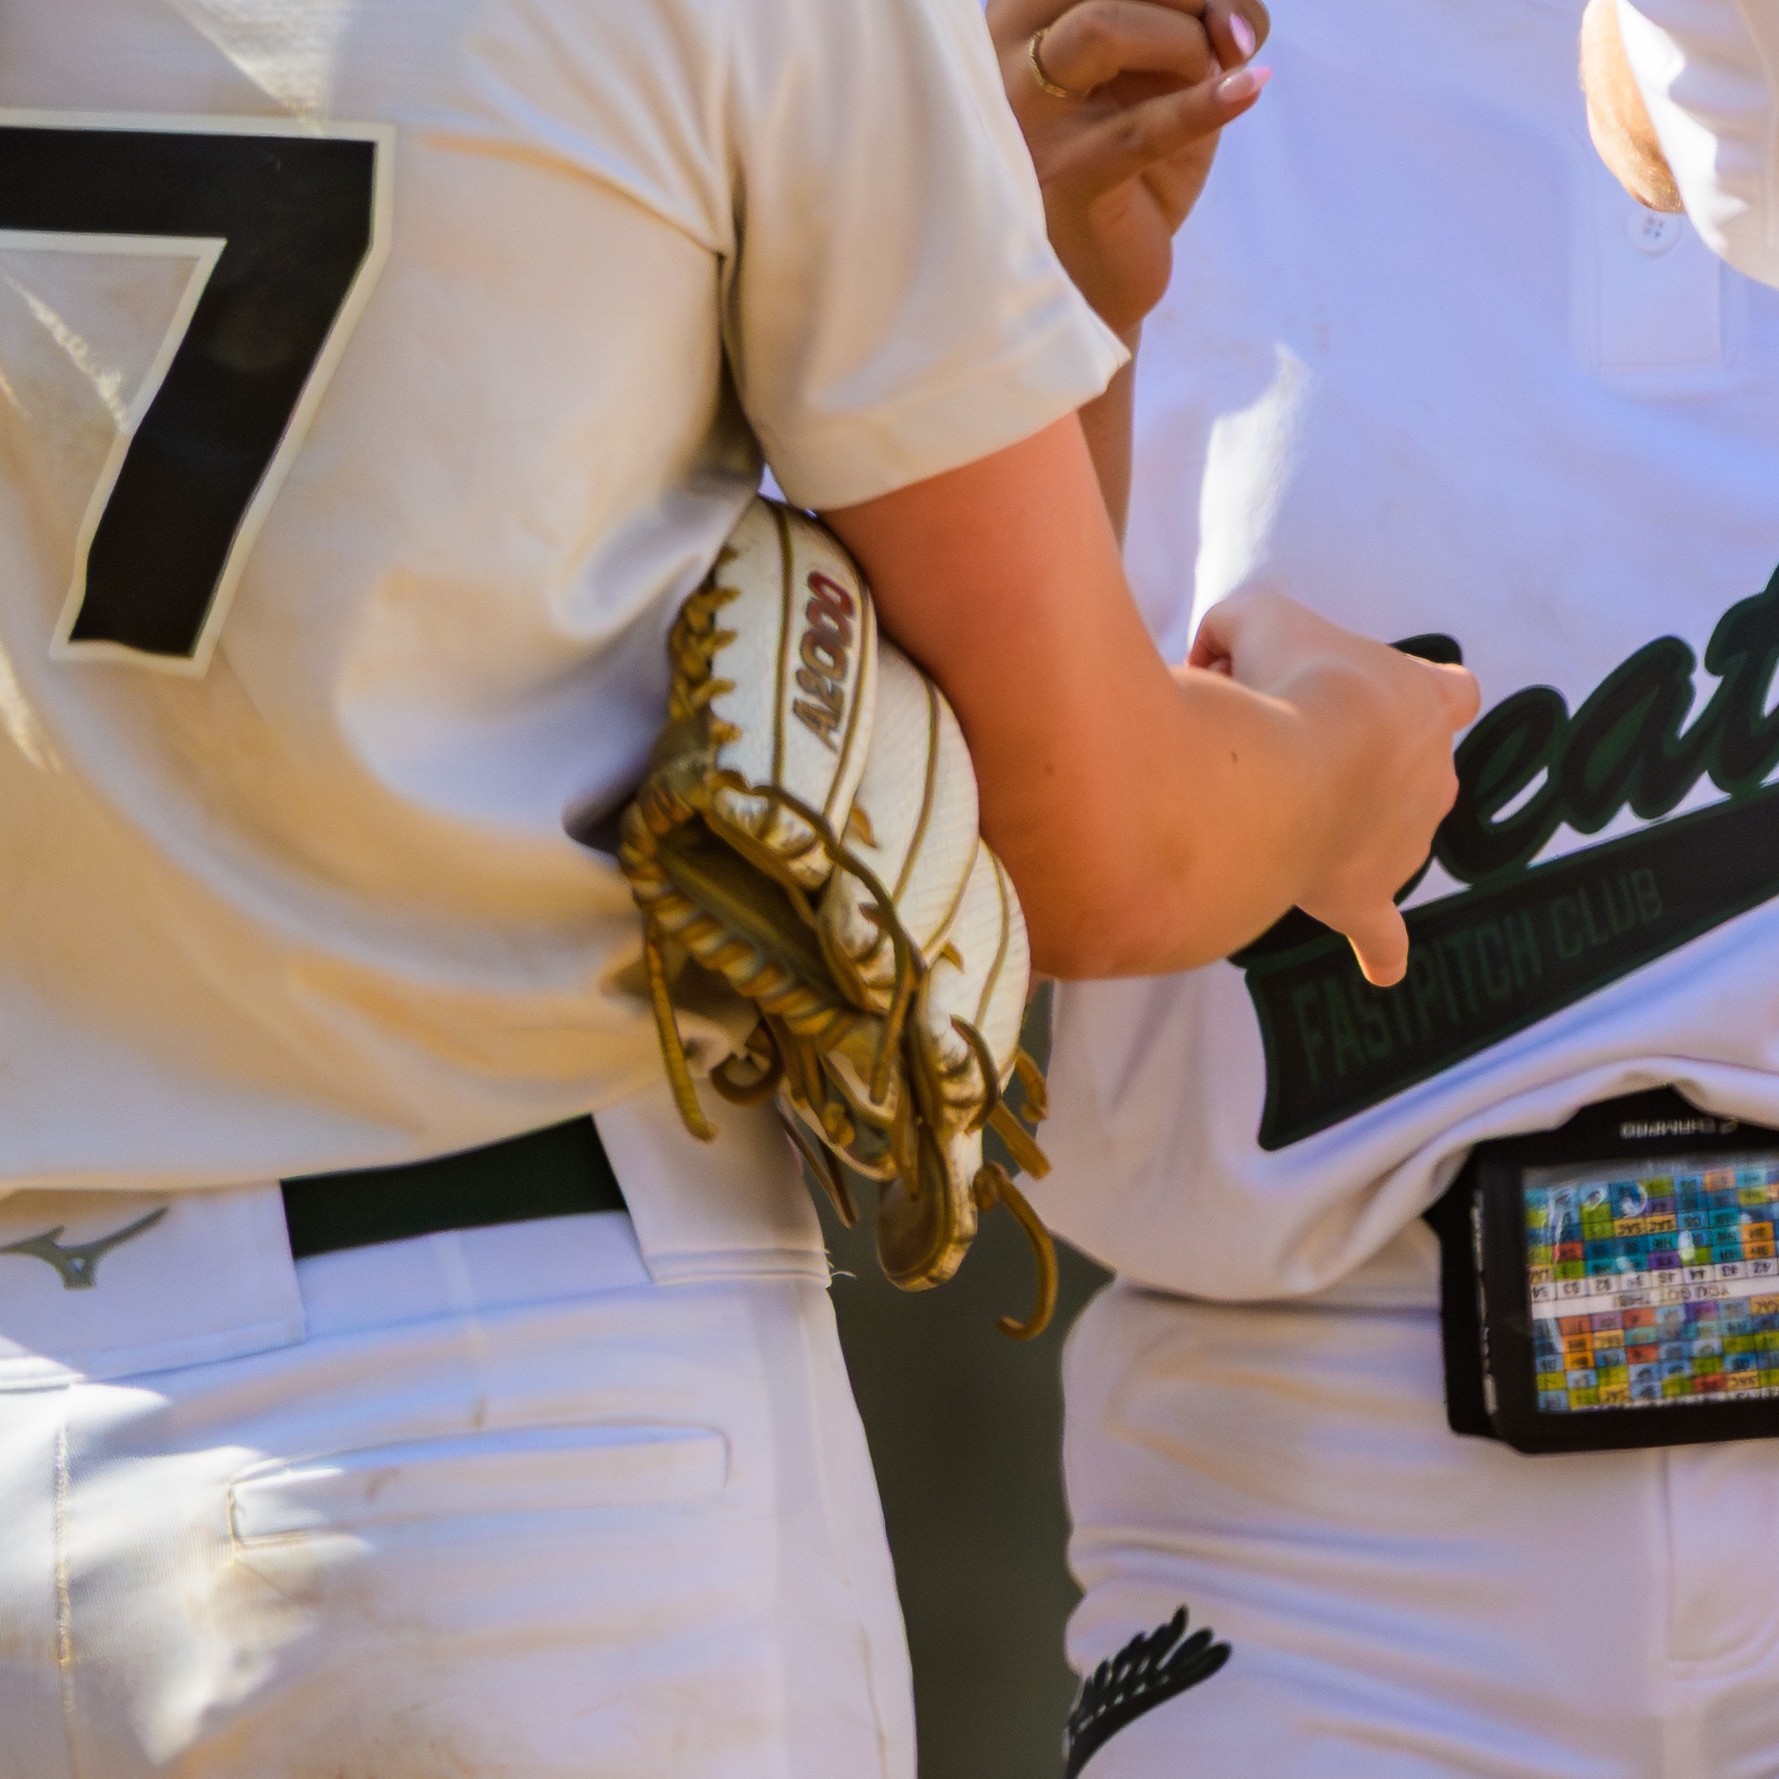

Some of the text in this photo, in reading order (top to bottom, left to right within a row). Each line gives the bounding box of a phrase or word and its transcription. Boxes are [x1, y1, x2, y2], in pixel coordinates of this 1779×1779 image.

[0, 108, 397, 680] 7
[792, 570, 857, 752] A2000
[1288, 865, 1664, 1090] FASTPITCH CLUB
